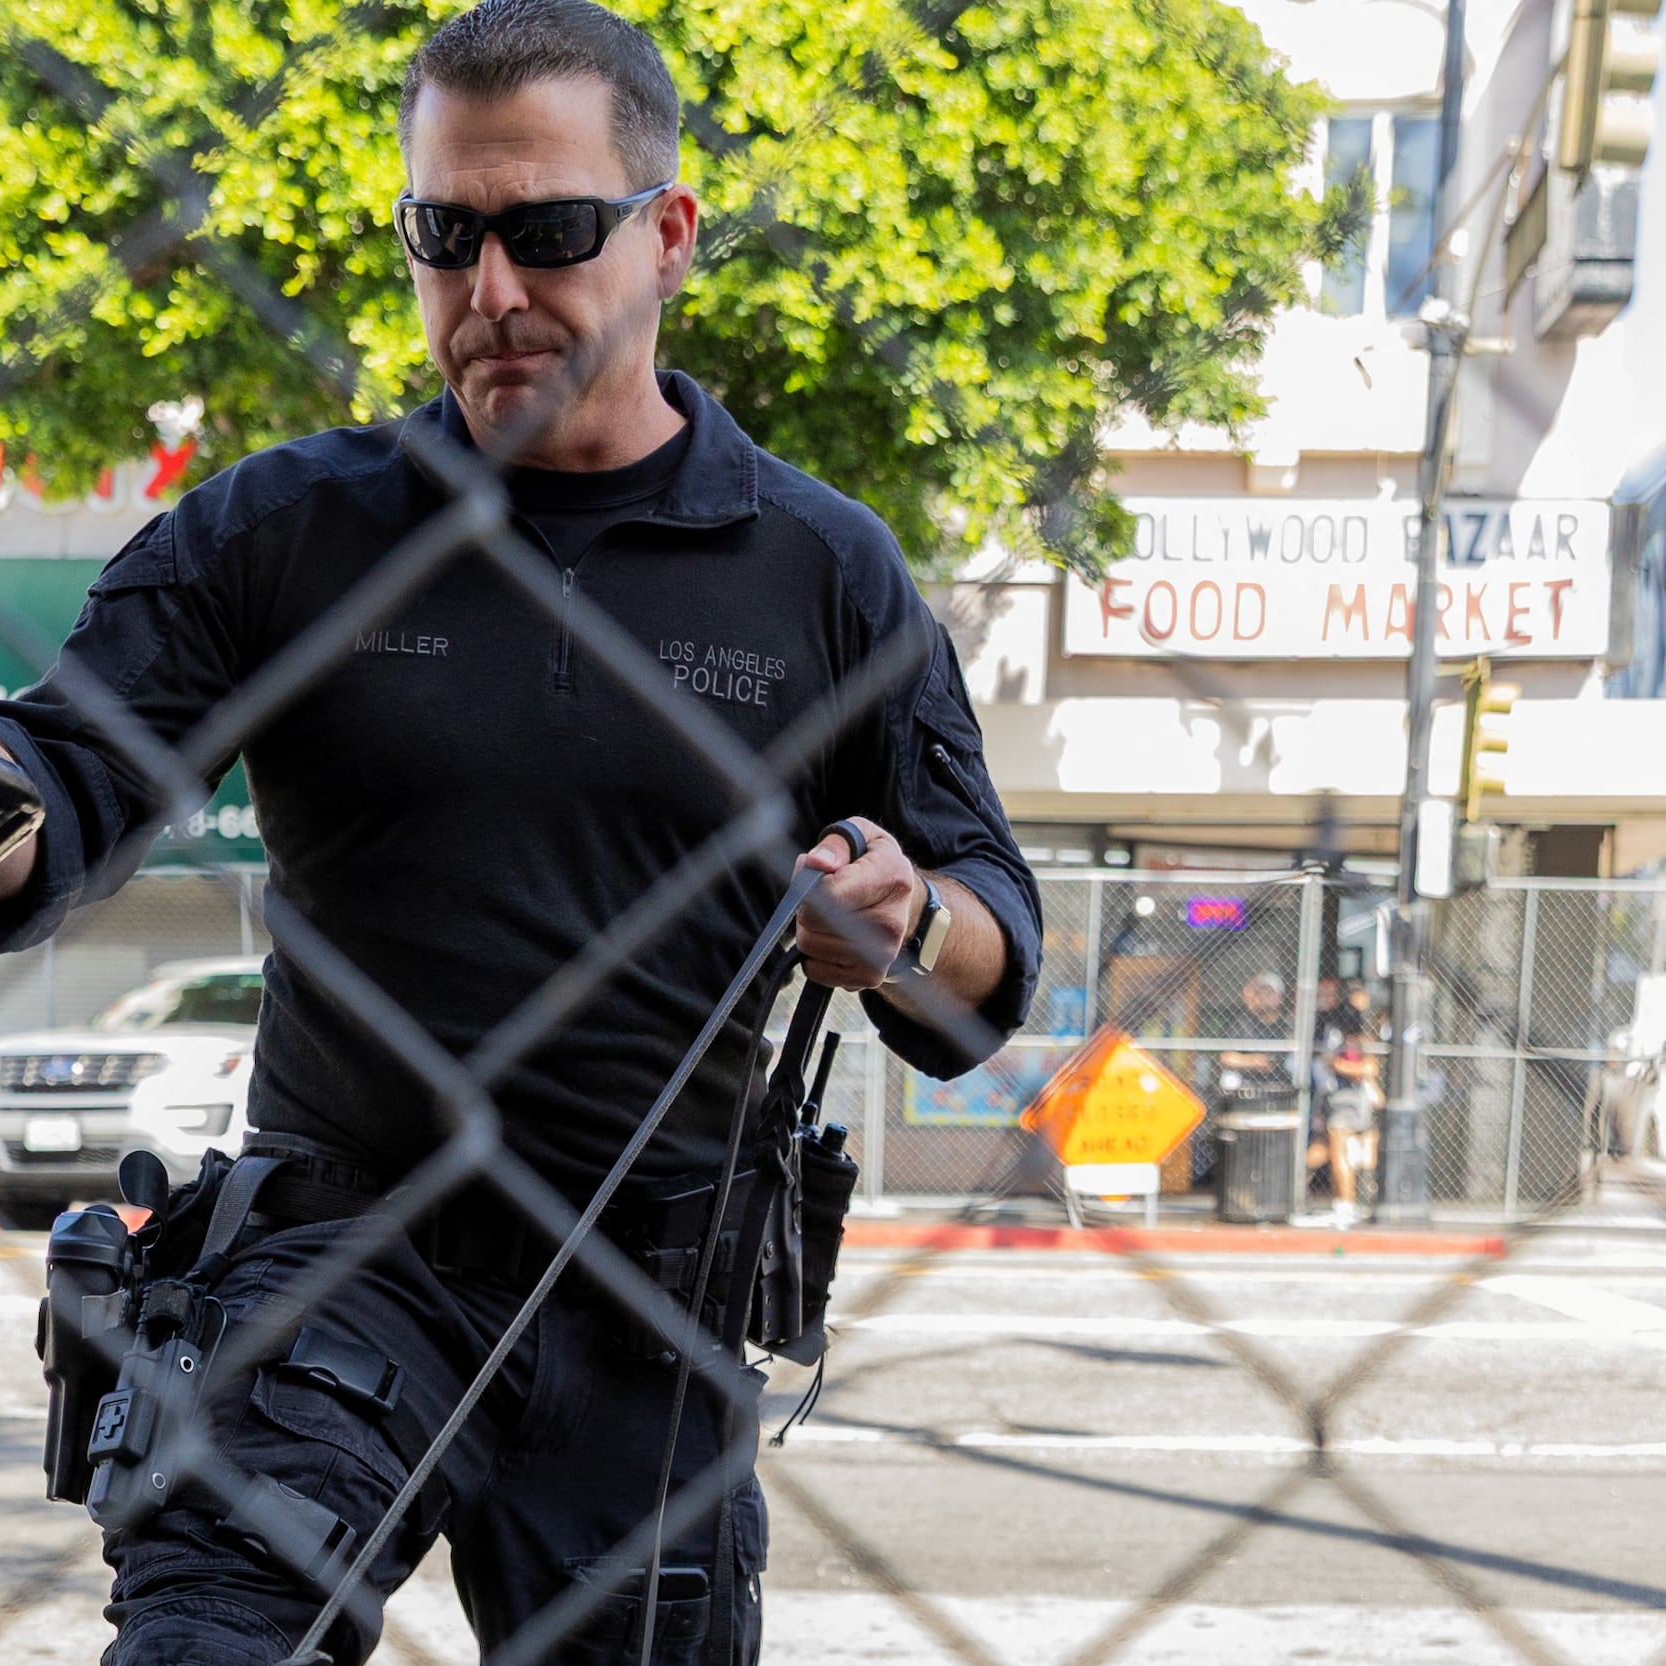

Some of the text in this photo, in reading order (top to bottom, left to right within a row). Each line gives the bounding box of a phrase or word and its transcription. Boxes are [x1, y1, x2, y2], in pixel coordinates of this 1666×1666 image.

[1132, 512, 1369, 564] OLLYWOOD
[1099, 577, 1575, 644] FOOD MARKET
[355, 629, 450, 657] MILLER
[659, 639, 786, 681] LOS ANGELES
[673, 664, 770, 707] POLICE
